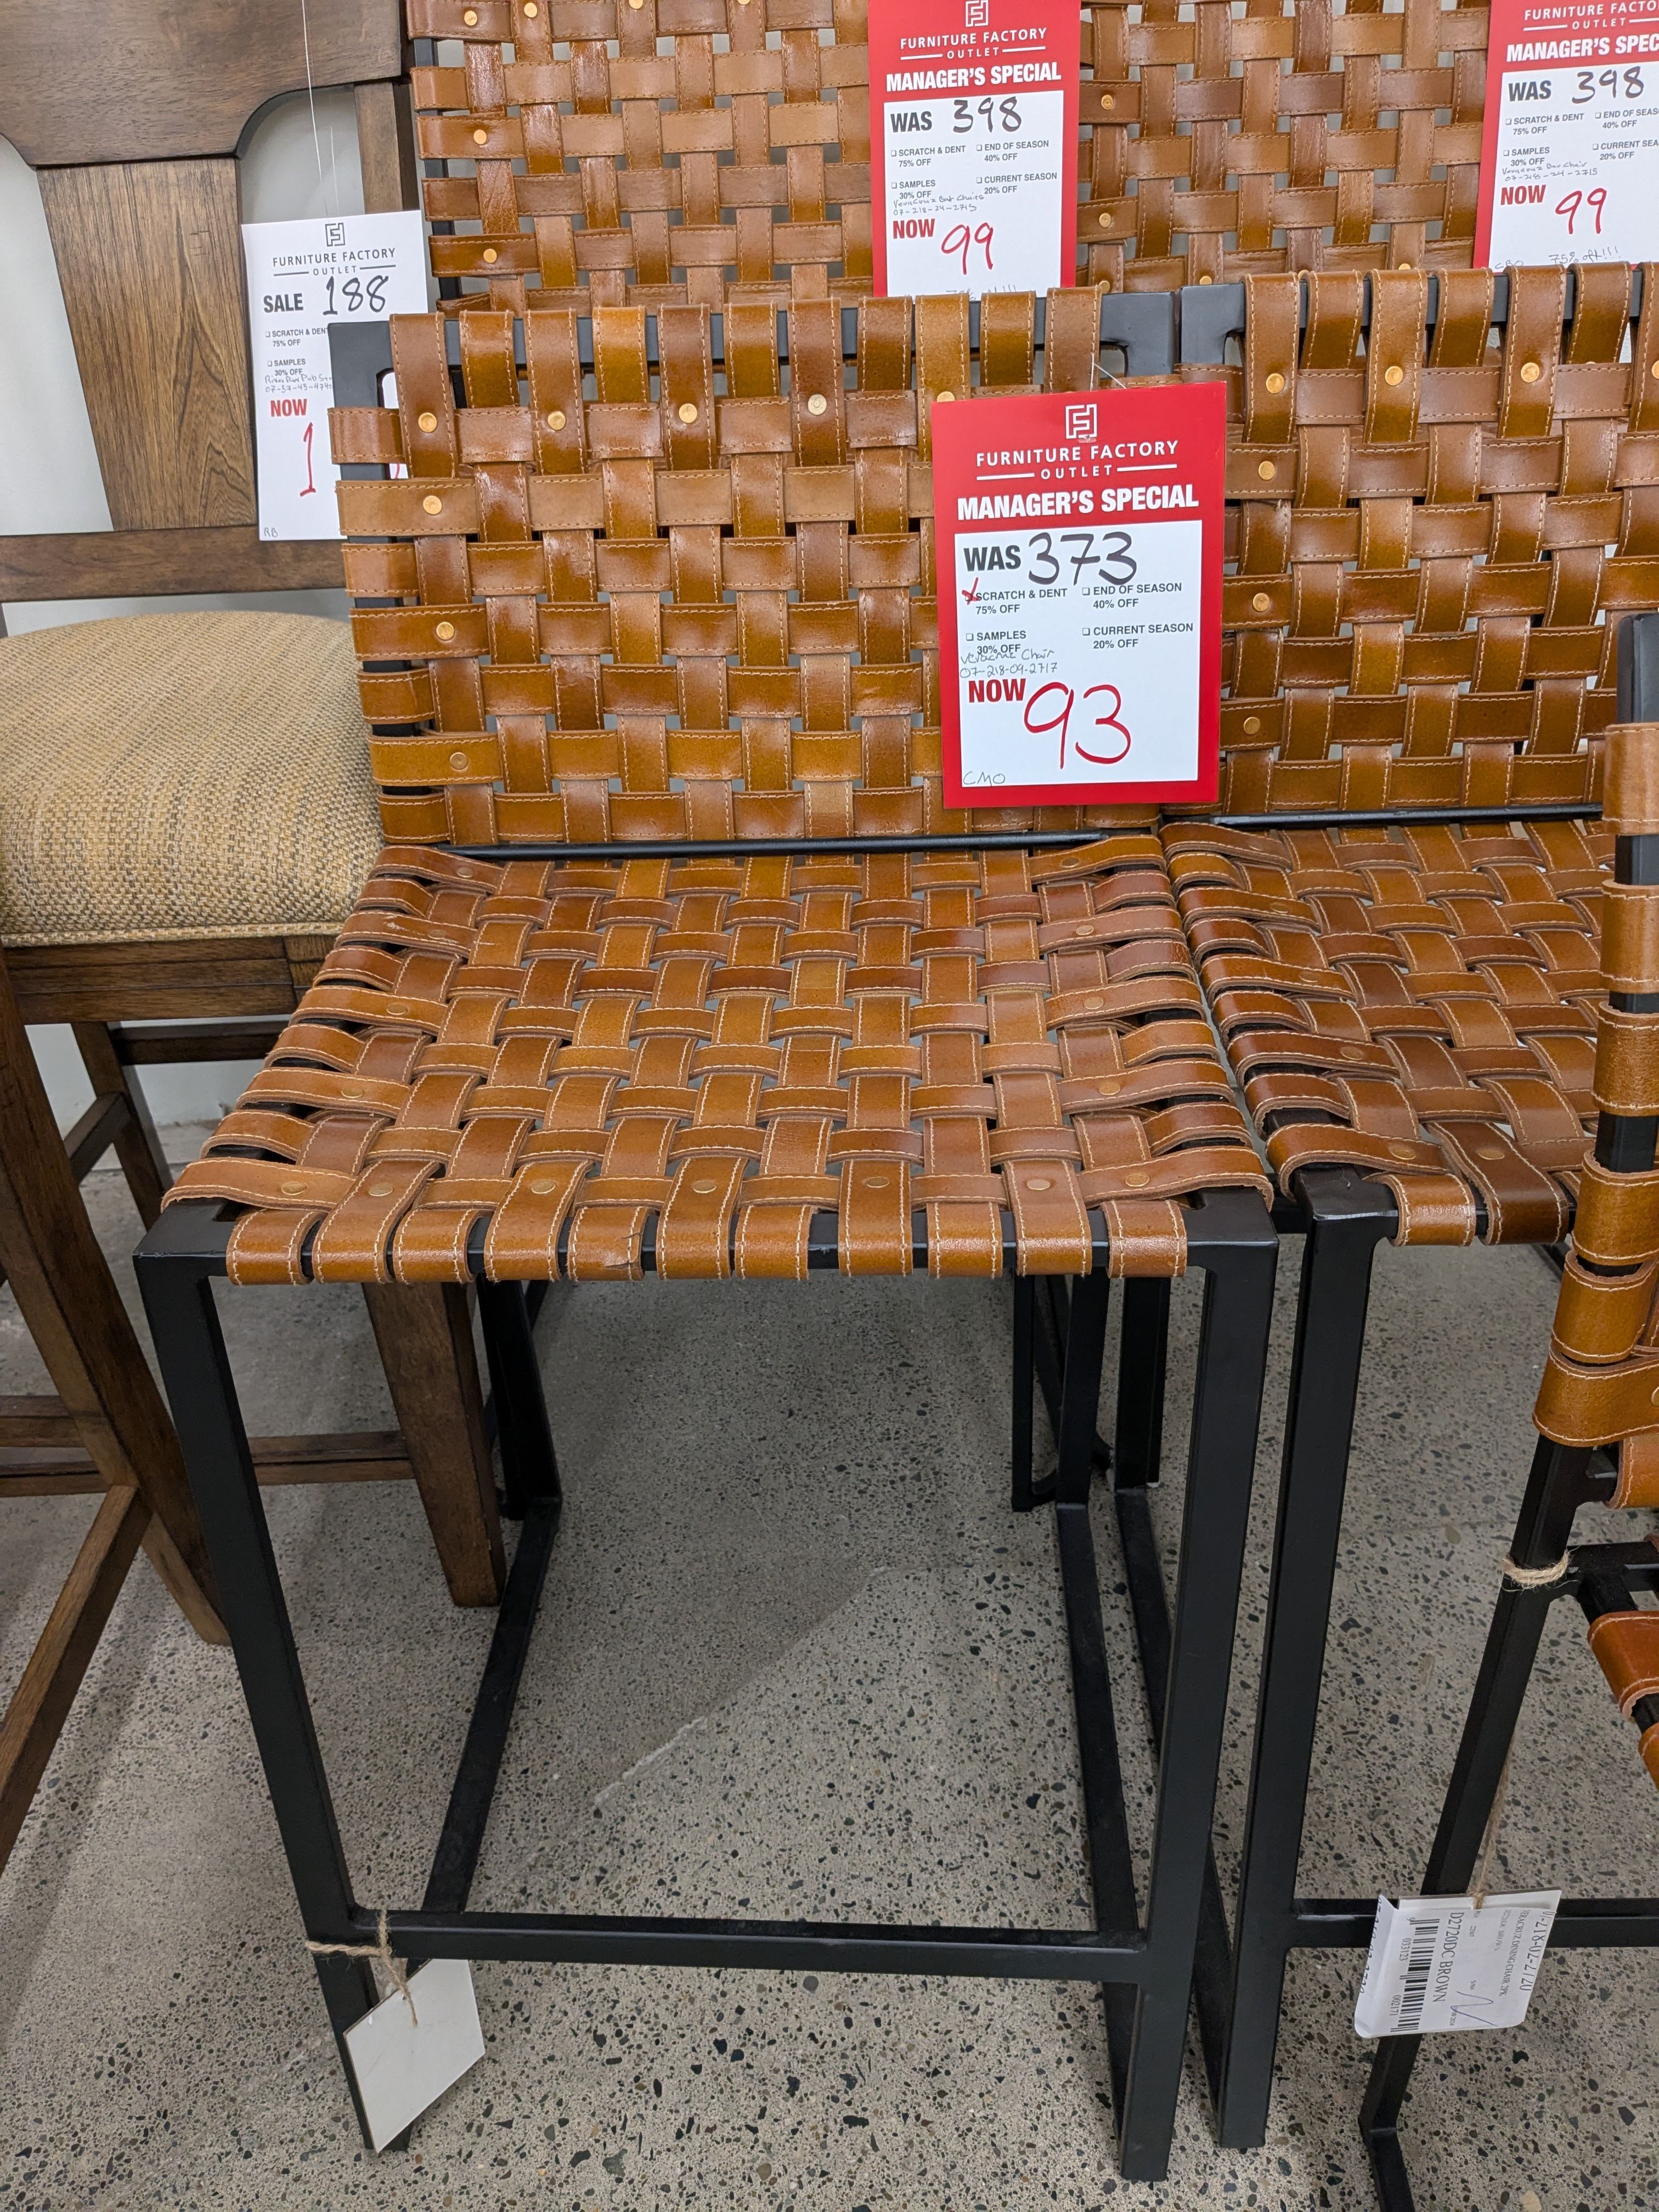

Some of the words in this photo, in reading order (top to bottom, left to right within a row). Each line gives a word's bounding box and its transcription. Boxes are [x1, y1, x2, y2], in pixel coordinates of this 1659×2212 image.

[1525, 4, 1604, 21] FURNITURE
[1610, 1, 1659, 14] FACTO
[1572, 18, 1626, 30] OUTLET
[900, 32, 977, 49] FURNITURE
[983, 27, 1047, 43] FACTORY
[947, 47, 998, 59] OUTLET
[1506, 37, 1610, 62] MANAGER'S
[886, 67, 985, 92] MANAGER'S
[991, 61, 1062, 84] SPECIAL
[1509, 80, 1551, 102] WAS
[1572, 66, 1644, 104] 398
[890, 111, 932, 133] WAS
[952, 96, 1022, 133] 398
[1636, 108, 1659, 116] SEAS
[1514, 115, 1552, 125] SCRATCH
[1562, 113, 1584, 122] DENT
[1621, 120, 1637, 128] OFF
[899, 147, 935, 156] SCRATCH
[945, 145, 966, 154] DENT
[984, 143, 1001, 151] END
[1003, 142, 1014, 150] OF
[1015, 140, 1049, 149] SEASON
[1511, 147, 1550, 156] SAMPLES
[1600, 140, 1640, 150] CURRENT
[1510, 159, 1526, 167] 30%
[899, 179, 936, 189] SAMPLES
[984, 174, 1022, 184] CURRENT
[1024, 172, 1057, 182] SEASON
[916, 190, 932, 199] OFF
[984, 187, 1000, 195] 20%
[1500, 185, 1546, 206] NOW
[1555, 188, 1607, 234] 99
[893, 218, 936, 239] NOW
[941, 222, 994, 275] 99
[273, 252, 337, 267] FURNITURE
[343, 247, 396, 261] FACTORY
[1549, 251, 1578, 264] 75%
[313, 266, 357, 275] OUTLET
[263, 293, 303, 313] SALE
[323, 275, 389, 315] 188
[274, 358, 306, 366] SAMPLES
[270, 398, 307, 417] NOW
[976, 446, 1081, 467] FURNITURE
[1091, 440, 1178, 460] FACTORY
[1041, 465, 1112, 479] OUTLET
[957, 489, 1093, 521] MANAGER'S
[1101, 484, 1199, 512] SPECIAL
[963, 545, 1021, 572] WAS
[1028, 531, 1137, 586] 373
[1093, 586, 1116, 595] END
[1119, 585, 1134, 594] OF
[1136, 583, 1182, 594] SEASON
[976, 590, 1025, 604] SCRATCH
[1029, 589, 1036, 599] &
[1039, 588, 1067, 598] DENT
[976, 606, 996, 614] 75%
[1000, 604, 1020, 613] OFF
[1093, 600, 1114, 609] 40%
[1118, 599, 1138, 608] OFF
[976, 630, 1026, 641] SAMPLES
[1093, 625, 1145, 636] CURRENT
[1148, 623, 1193, 634] SEASON
[977, 645, 997, 654] 30%
[1000, 644, 1020, 653] OFF
[1093, 640, 1114, 649] 20%
[1118, 639, 1138, 648] OFF
[1021, 648, 1054, 661] Chair
[968, 679, 1026, 703] NOW
[1024, 681, 1131, 770] 93
[1441, 1912, 1465, 1958] D2720DC
[1399, 1938, 1412, 1961] 033123
[1507, 1941, 1520, 1963] DINING
[1502, 1964, 1514, 1984] CHAIR
[1433, 1960, 1453, 2002] BROWN
[1389, 1995, 1402, 2017] 002171
